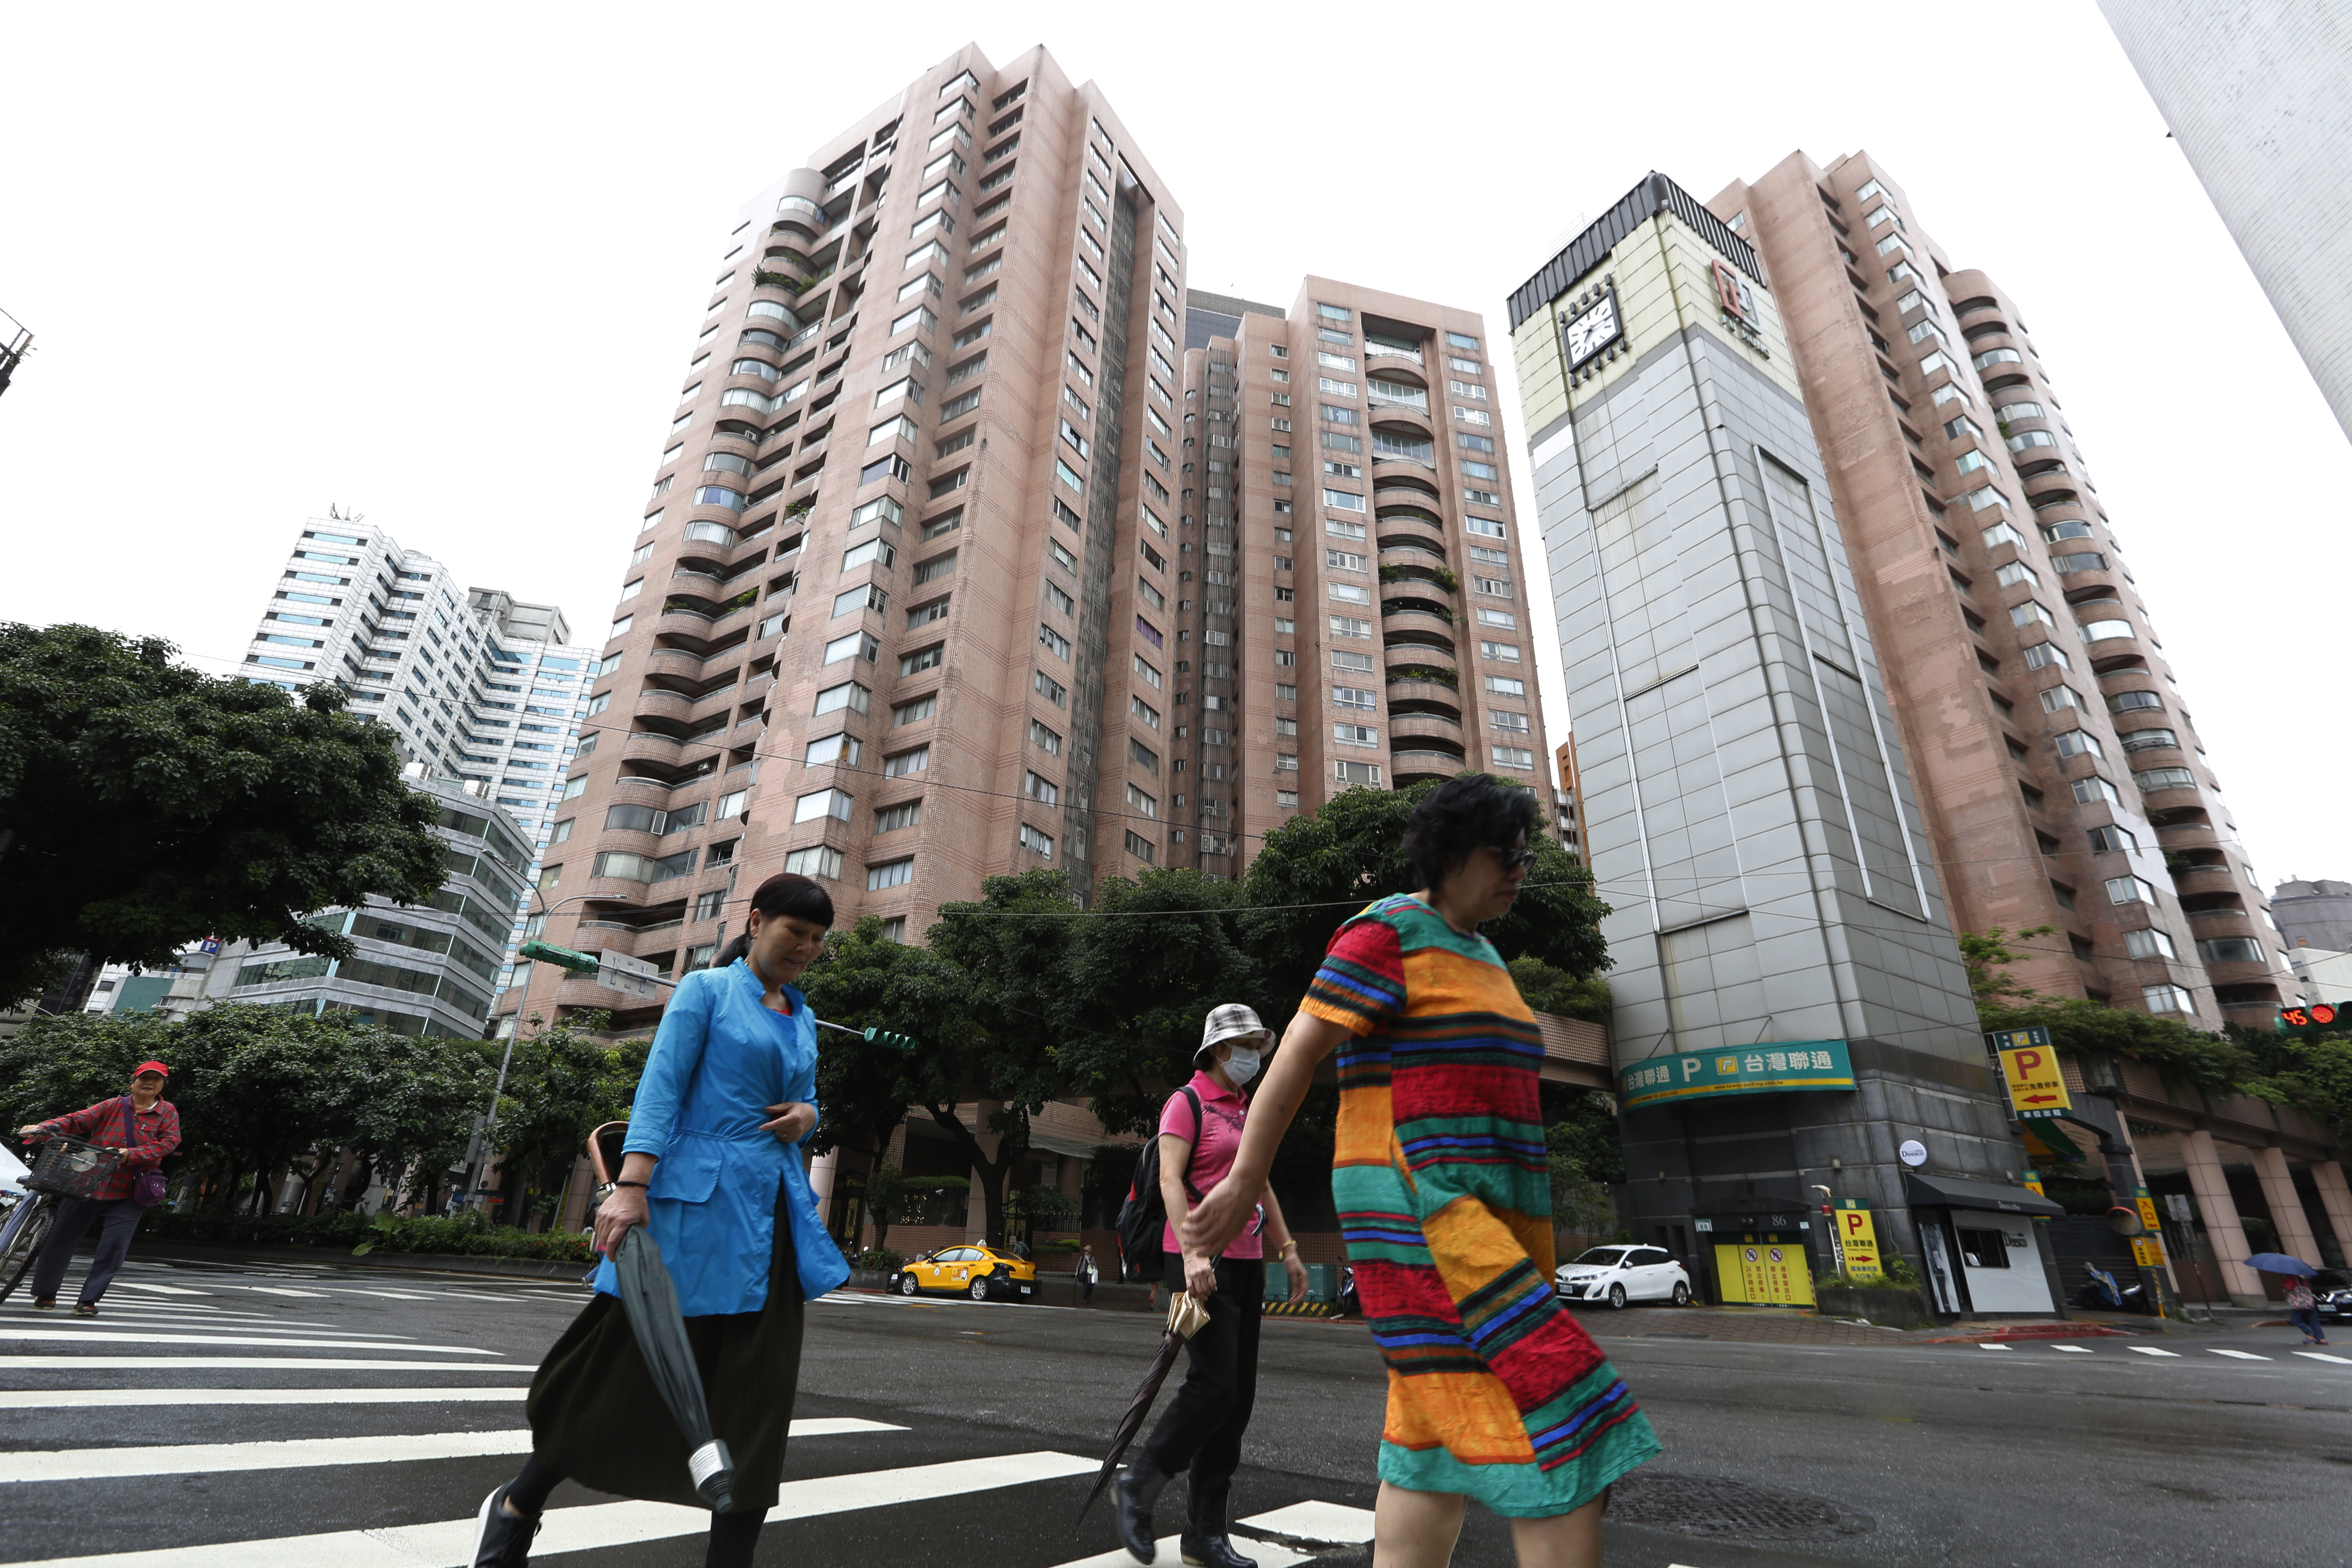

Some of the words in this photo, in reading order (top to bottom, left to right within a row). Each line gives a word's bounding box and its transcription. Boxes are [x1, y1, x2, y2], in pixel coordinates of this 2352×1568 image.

[203, 941, 216, 951] P
[2282, 1009, 2307, 1025] 45
[1682, 1058, 1702, 1082] P
[1744, 1051, 1833, 1072] 台灣聯通
[2015, 1051, 2041, 1080] P
[1628, 1065, 1670, 1090] 台灣聯通
[1772, 1214, 1786, 1226] 86
[2142, 1200, 2155, 1220] 入口
[1847, 1214, 1863, 1235] P
